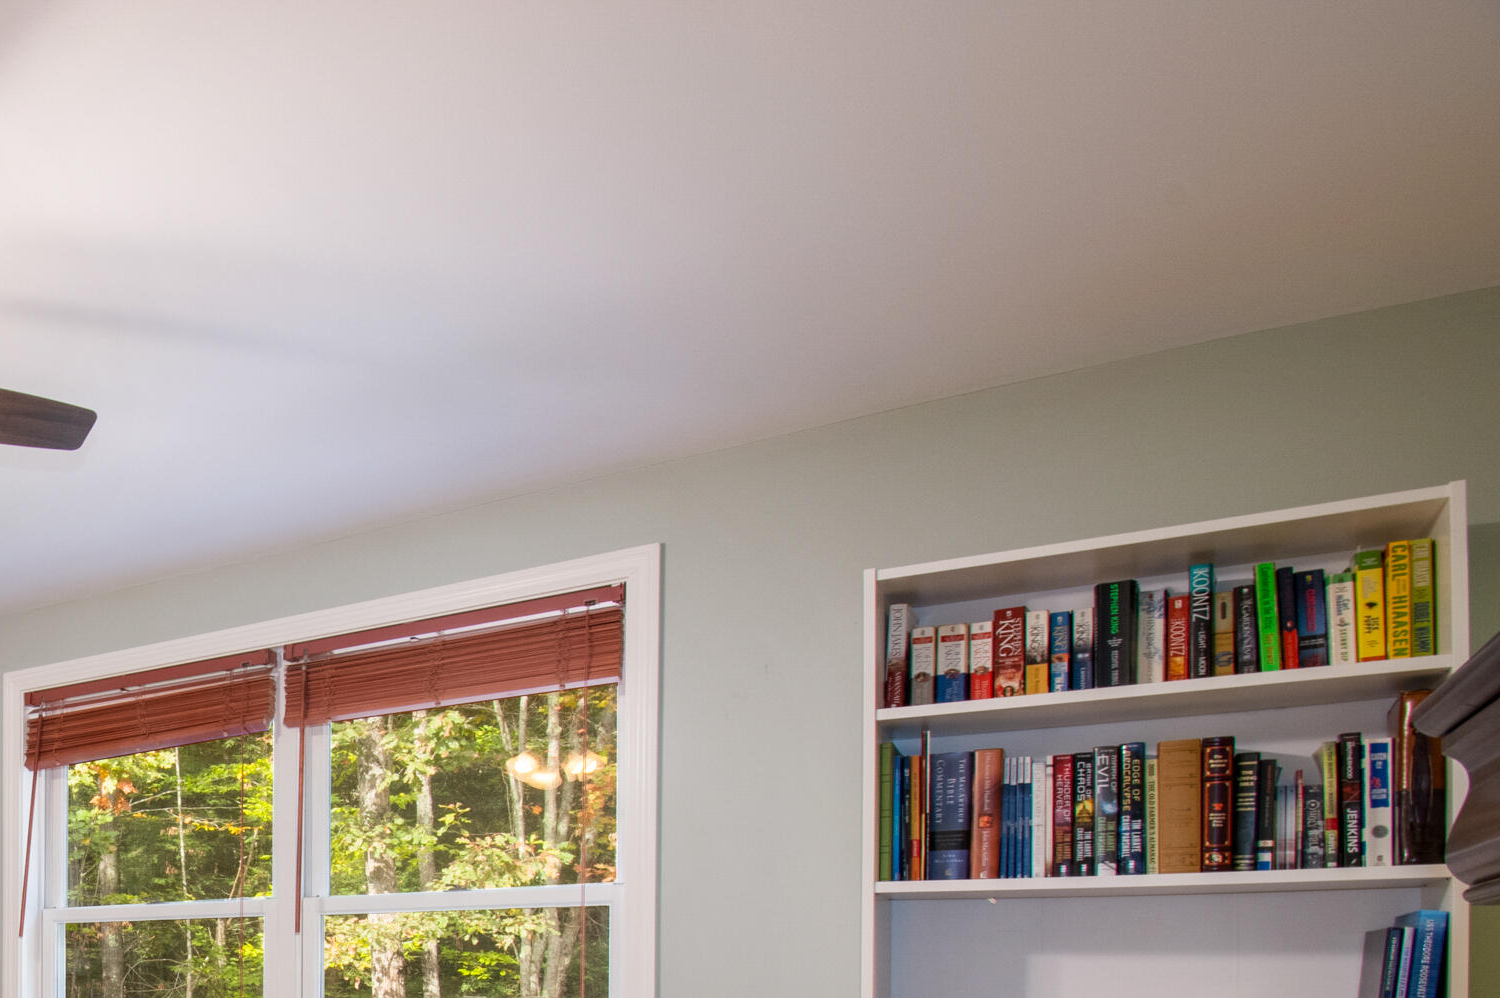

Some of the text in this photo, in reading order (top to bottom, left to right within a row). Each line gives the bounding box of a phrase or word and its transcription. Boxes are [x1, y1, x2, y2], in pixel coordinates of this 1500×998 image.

[1110, 584, 1118, 634] STEPHEN KING
[1192, 571, 1209, 622] KOONTZ
[1392, 544, 1409, 656] CARL HIAASEN
[891, 608, 903, 657] JOHN JAKES
[996, 619, 1013, 657] KING
[1011, 617, 1022, 655] STEPHEN
[1030, 627, 1038, 649] KING
[1053, 626, 1063, 651] KING
[1076, 625, 1084, 648] KING
[1171, 621, 1185, 656] KOONTZ
[958, 759, 966, 772] THE
[1077, 761, 1085, 801] CHAOS
[1098, 754, 1109, 795] EVIL
[1123, 750, 1131, 811] APOCALYPSE
[1132, 759, 1140, 801] EDGE OF
[935, 759, 944, 824] COMMENTARY
[947, 778, 956, 805] BIBLE
[1063, 763, 1071, 823] THUNDER OF
[1086, 789, 1092, 799] OF
[1111, 782, 1117, 793] OF
[1084, 831, 1092, 857] TIM LAHAYE
[1122, 816, 1130, 858] CRAIG PARSHALL
[1131, 819, 1141, 852] TIM LAHAYE
[1347, 808, 1357, 853] JENKINS
[1425, 919, 1435, 931] USS
[1421, 932, 1434, 964] THEODORE
[1416, 964, 1429, 998] ROOSEVELT
